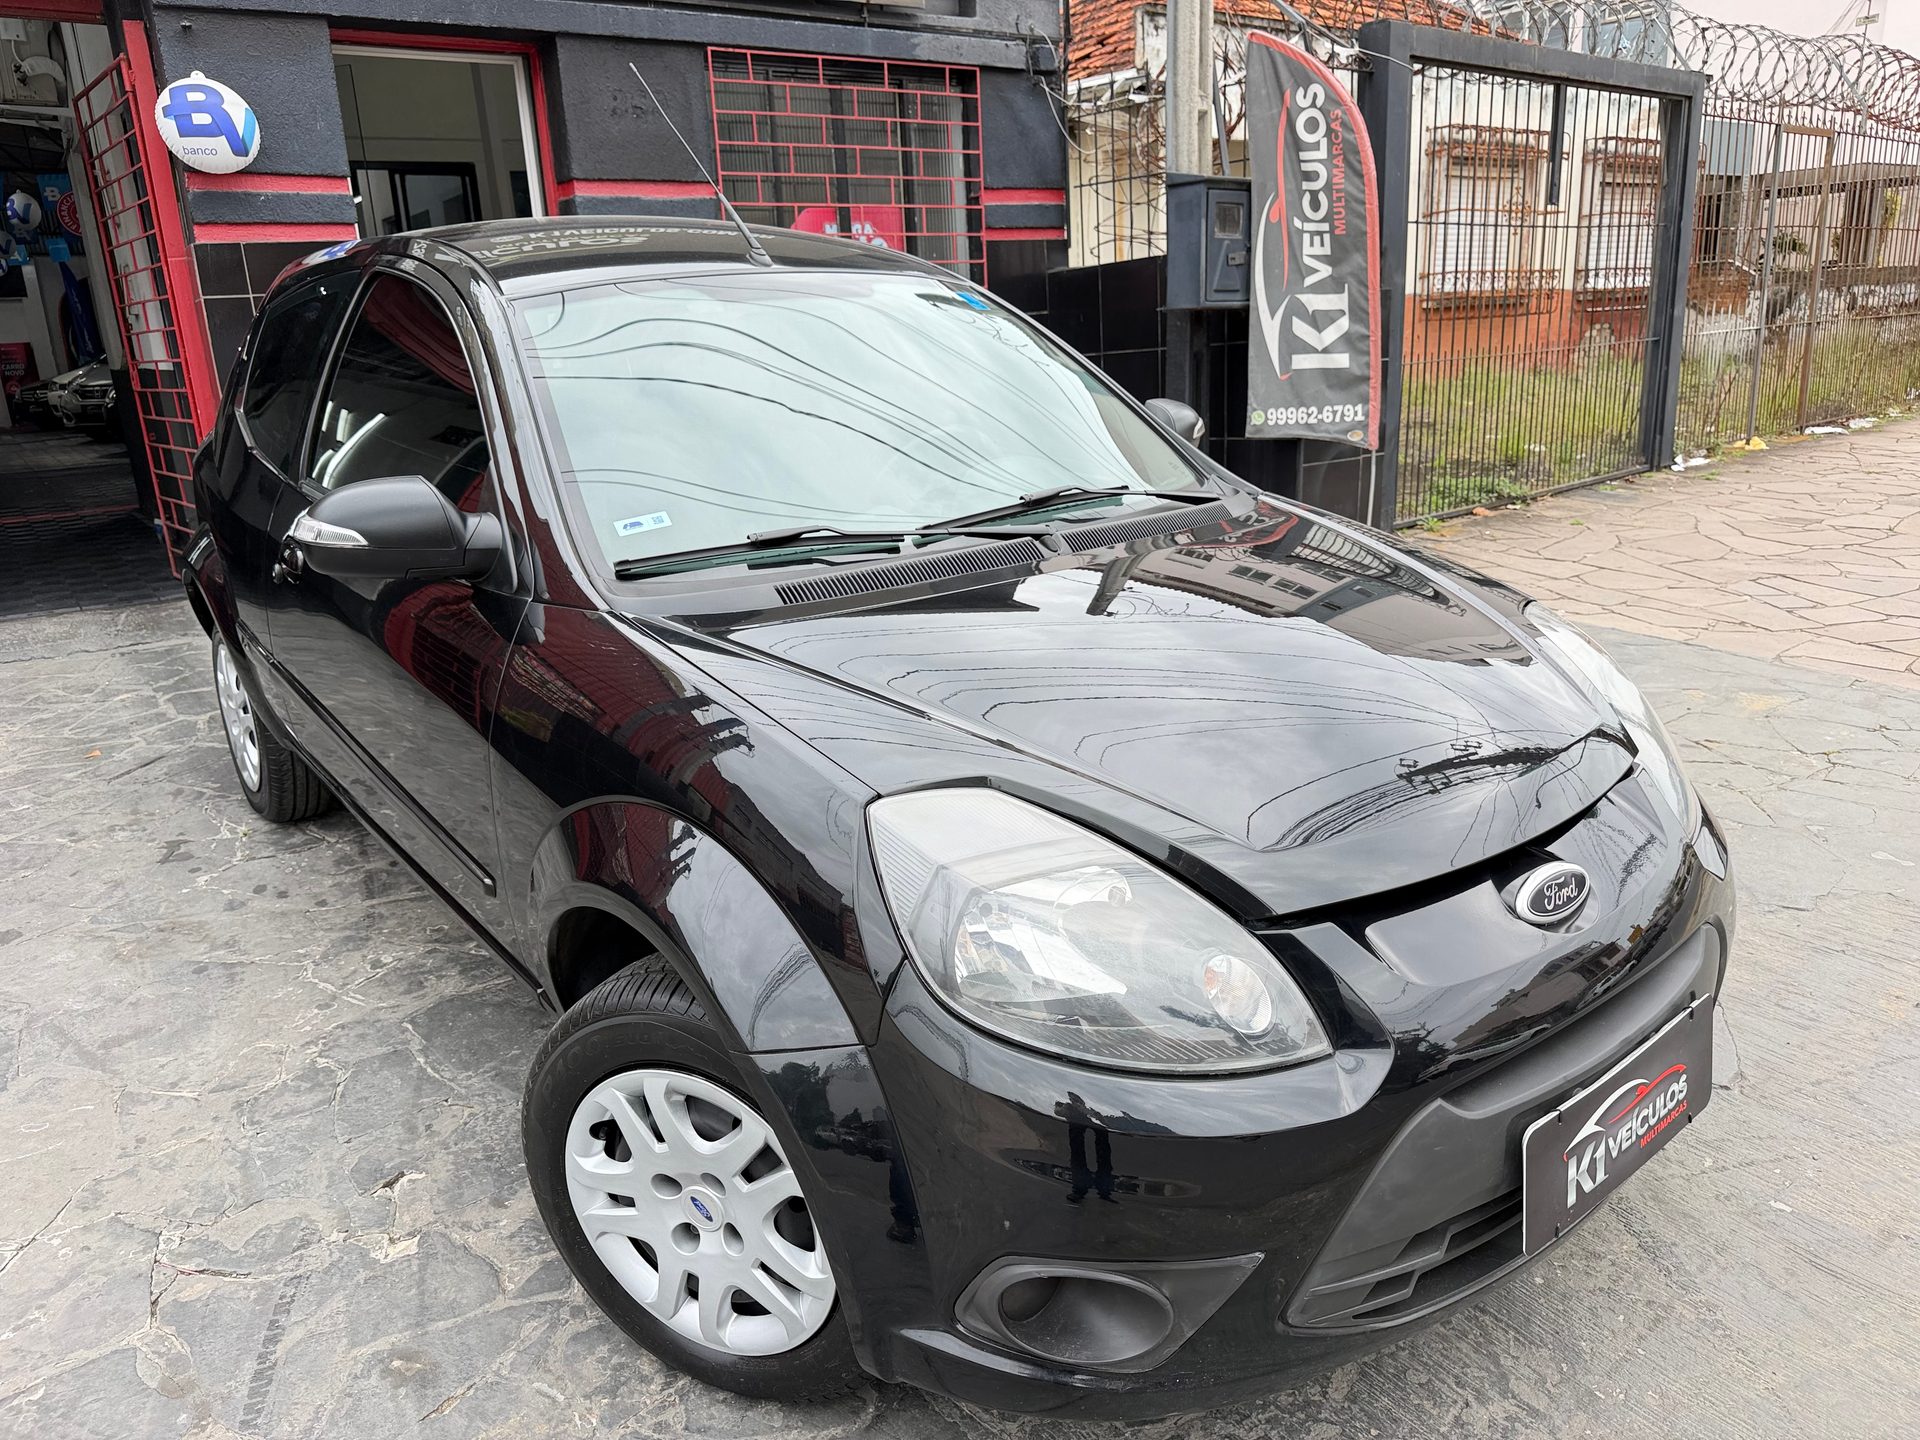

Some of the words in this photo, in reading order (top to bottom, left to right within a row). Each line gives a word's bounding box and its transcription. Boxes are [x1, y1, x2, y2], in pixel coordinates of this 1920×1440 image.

[182, 146, 218, 156] banco
[1329, 108, 1346, 235] MULTIMARCAS
[1293, 83, 1333, 288] VEÍCULOS
[1291, 283, 1348, 369] K1
[1267, 404, 1365, 426] 99962-6791
[1544, 876, 1578, 910] Ford
[1567, 1134, 1609, 1208] K1
[1608, 1074, 1687, 1159] VEÍCULOS
[1640, 1100, 1687, 1148] MULTIMARCAS
